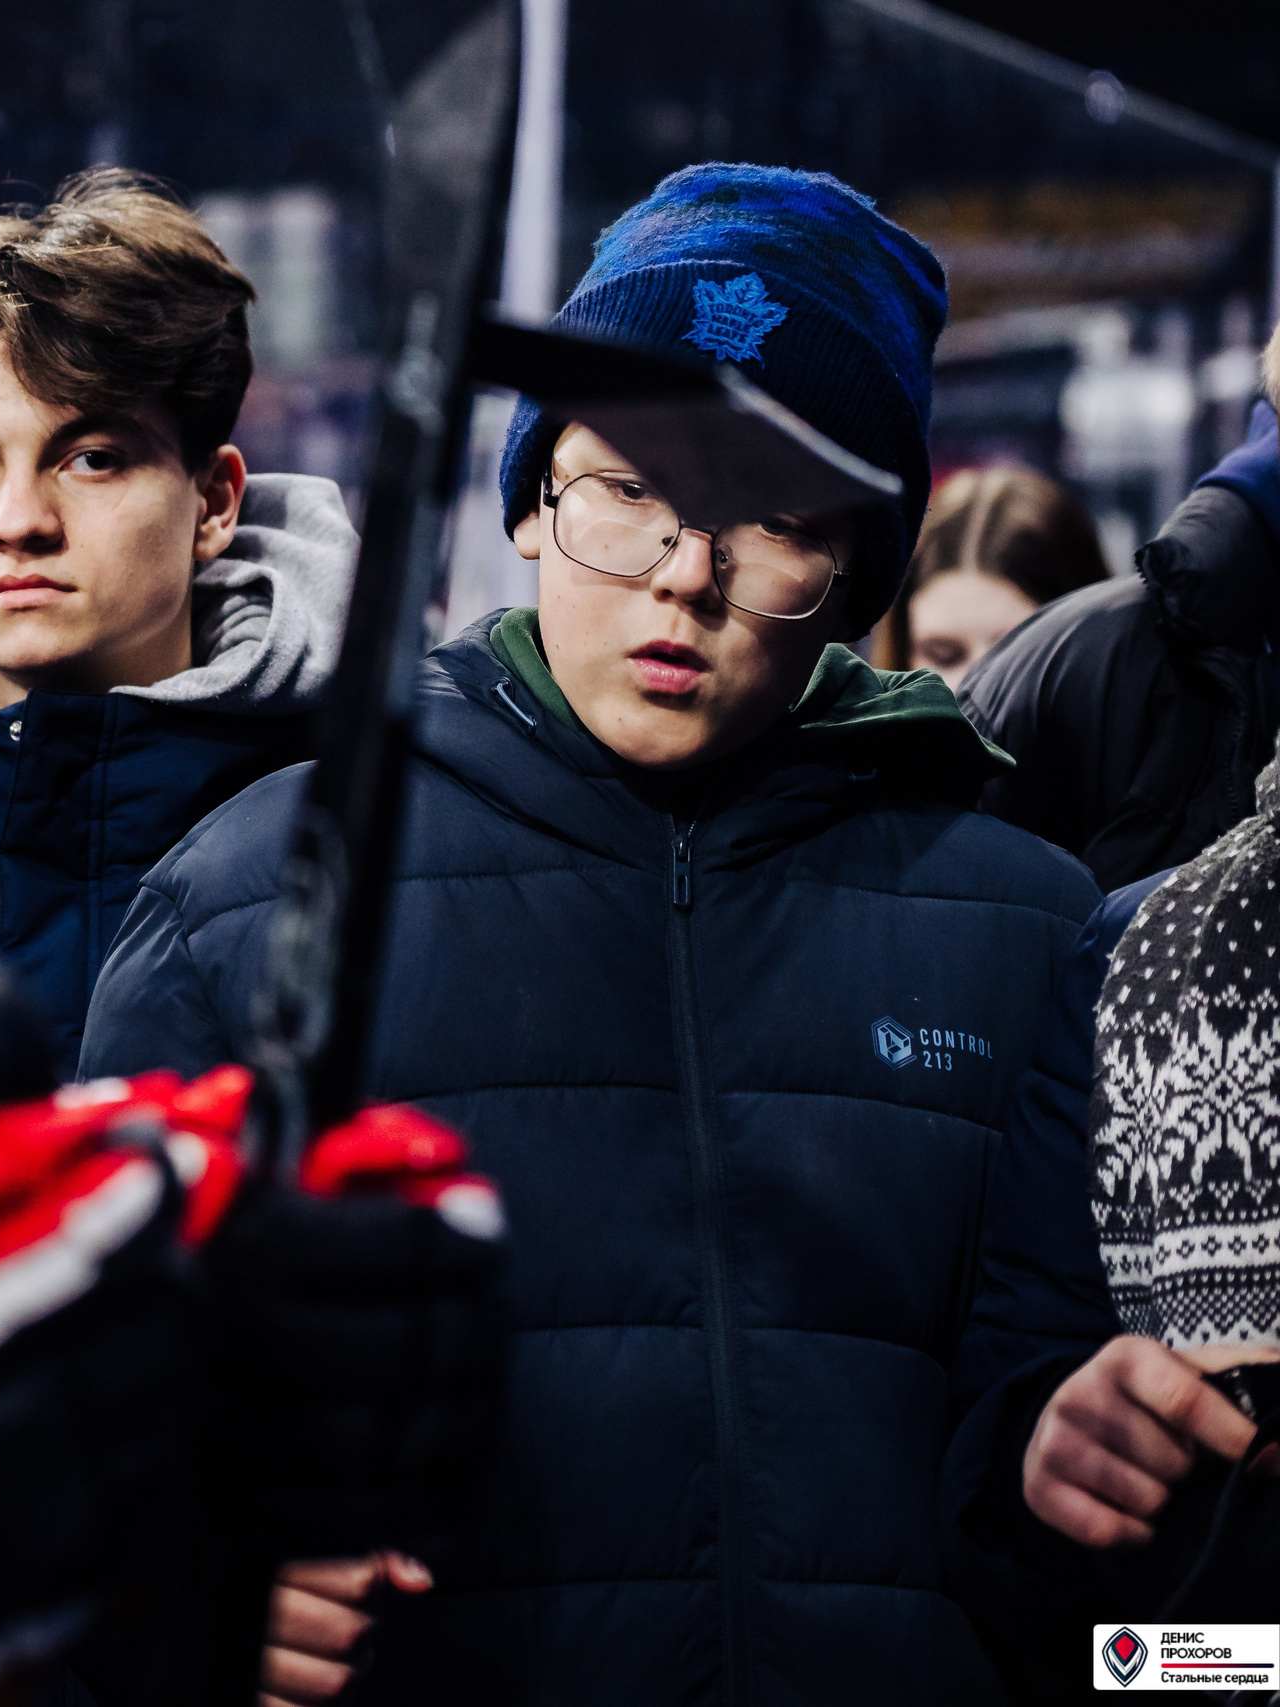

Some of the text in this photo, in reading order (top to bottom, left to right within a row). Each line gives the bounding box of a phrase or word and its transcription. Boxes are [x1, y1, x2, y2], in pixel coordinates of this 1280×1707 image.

[708, 301, 765, 328] TORONTO
[711, 313, 753, 334] MAPLE
[707, 323, 748, 343] LEAFS
[919, 1028, 993, 1060] CONTROL
[923, 1051, 953, 1072] 213
